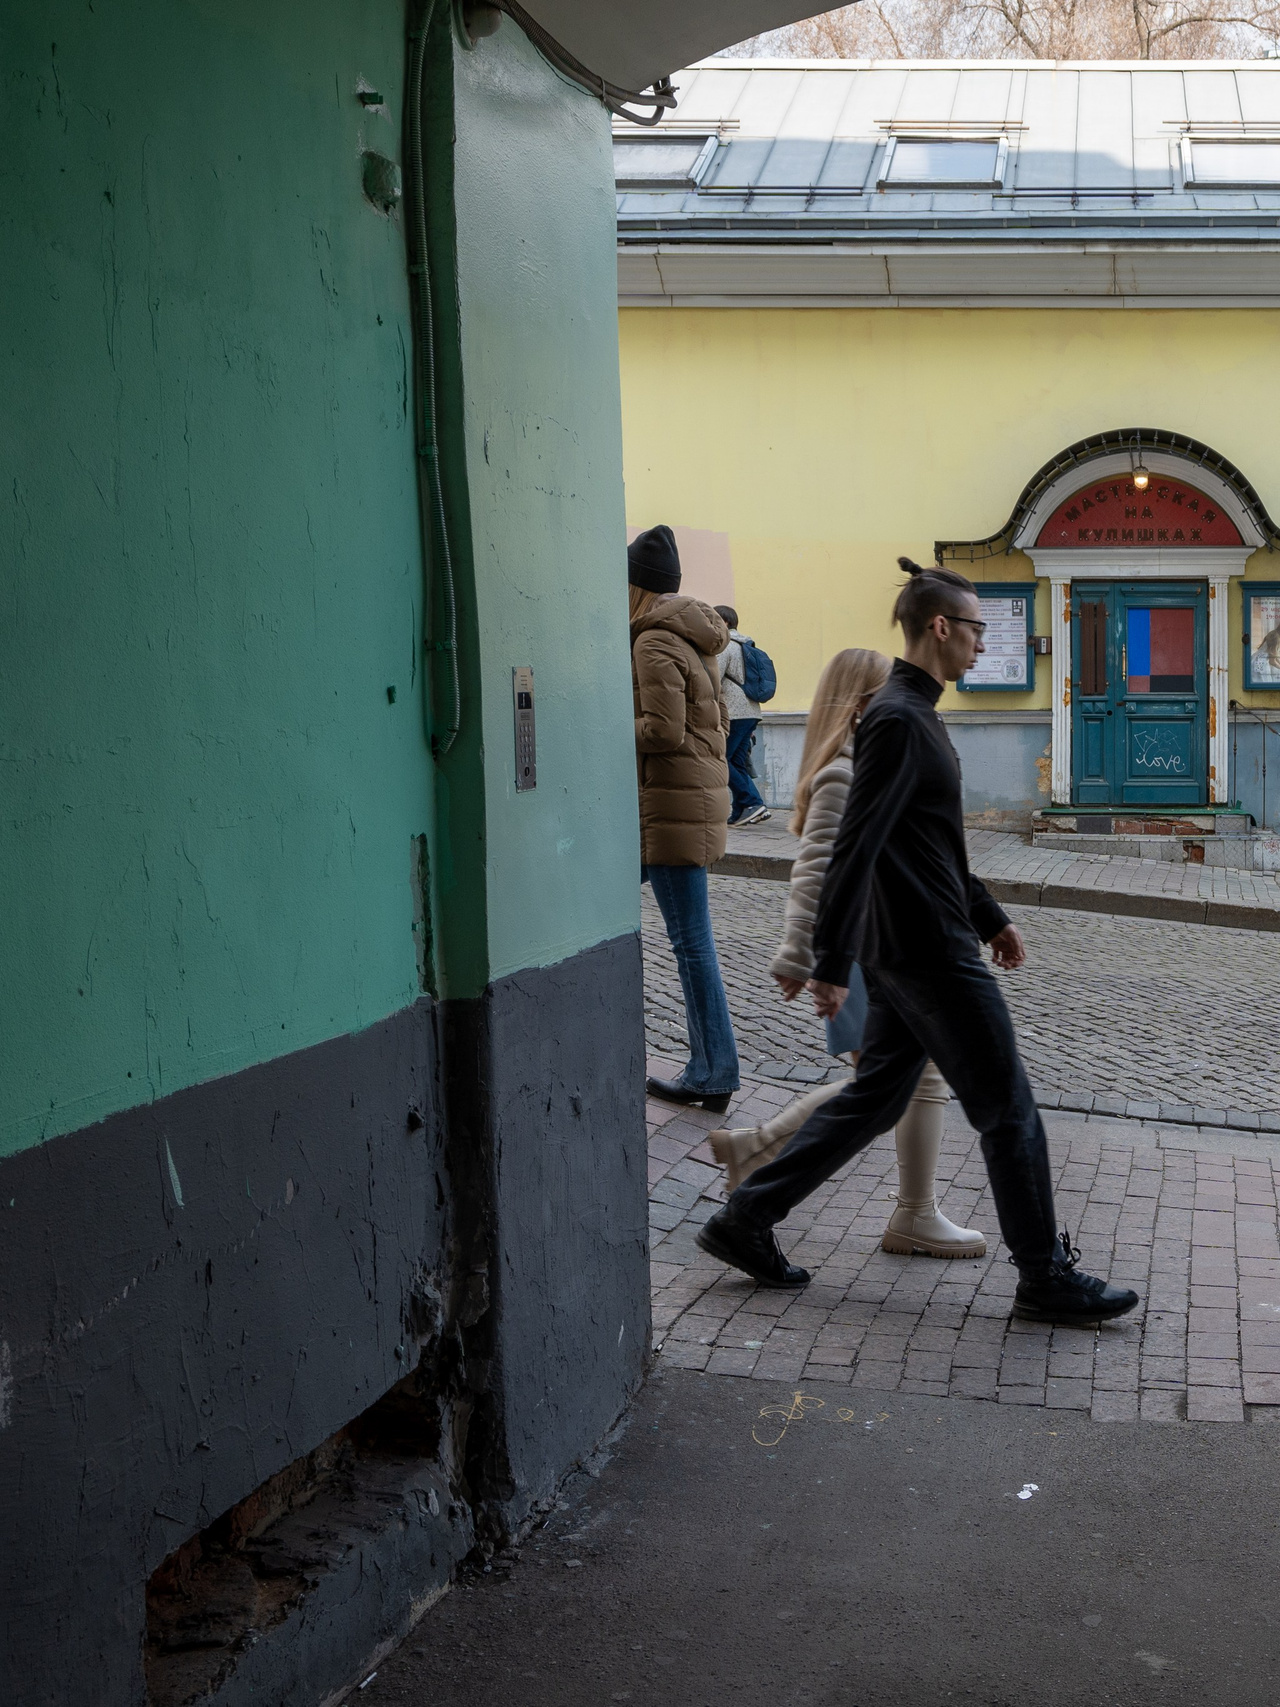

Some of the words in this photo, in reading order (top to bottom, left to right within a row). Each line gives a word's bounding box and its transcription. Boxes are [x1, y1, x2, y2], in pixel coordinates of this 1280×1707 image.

[1064, 484, 1217, 523] МАСТЕРСКАЯ
[1124, 506, 1153, 519] НА
[1078, 528, 1202, 541] КУЛИШКАХ
